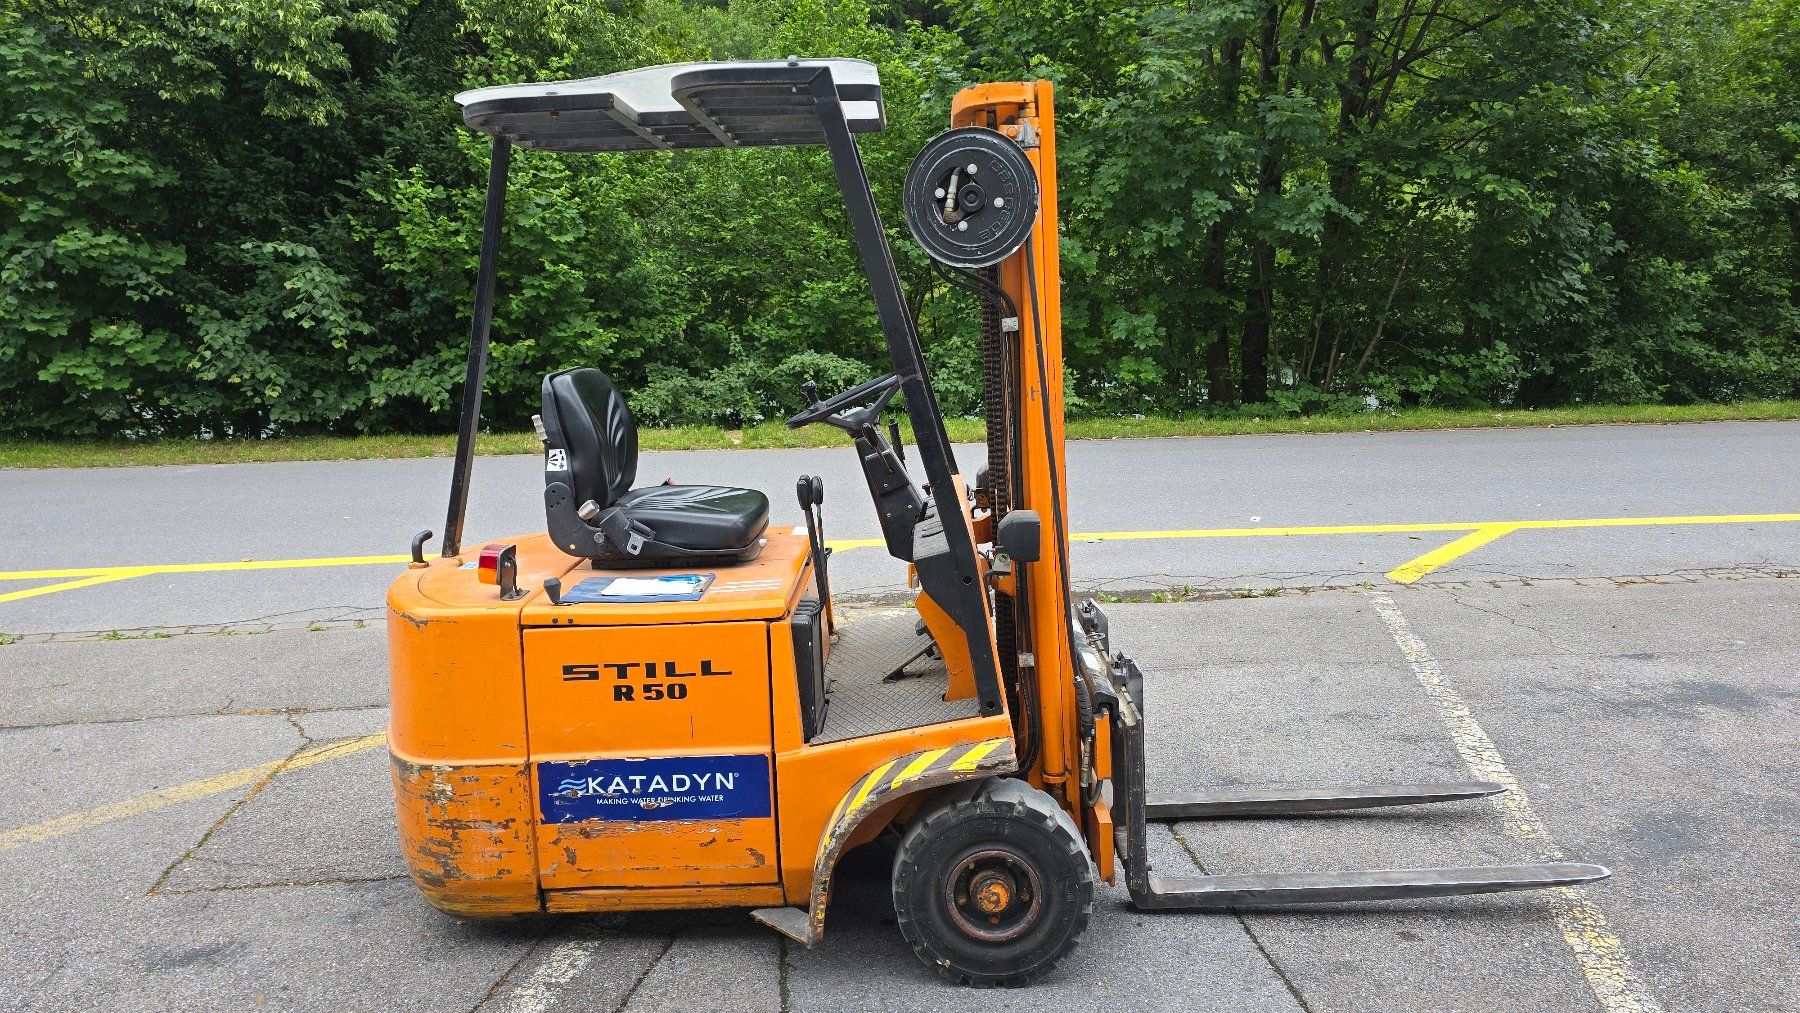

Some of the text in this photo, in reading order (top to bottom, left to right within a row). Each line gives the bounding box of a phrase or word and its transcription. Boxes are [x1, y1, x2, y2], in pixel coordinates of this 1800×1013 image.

[562, 660, 733, 681] STILL
[613, 683, 688, 701] R 50
[596, 797, 629, 805] MAKING
[698, 794, 724, 802] WATER
